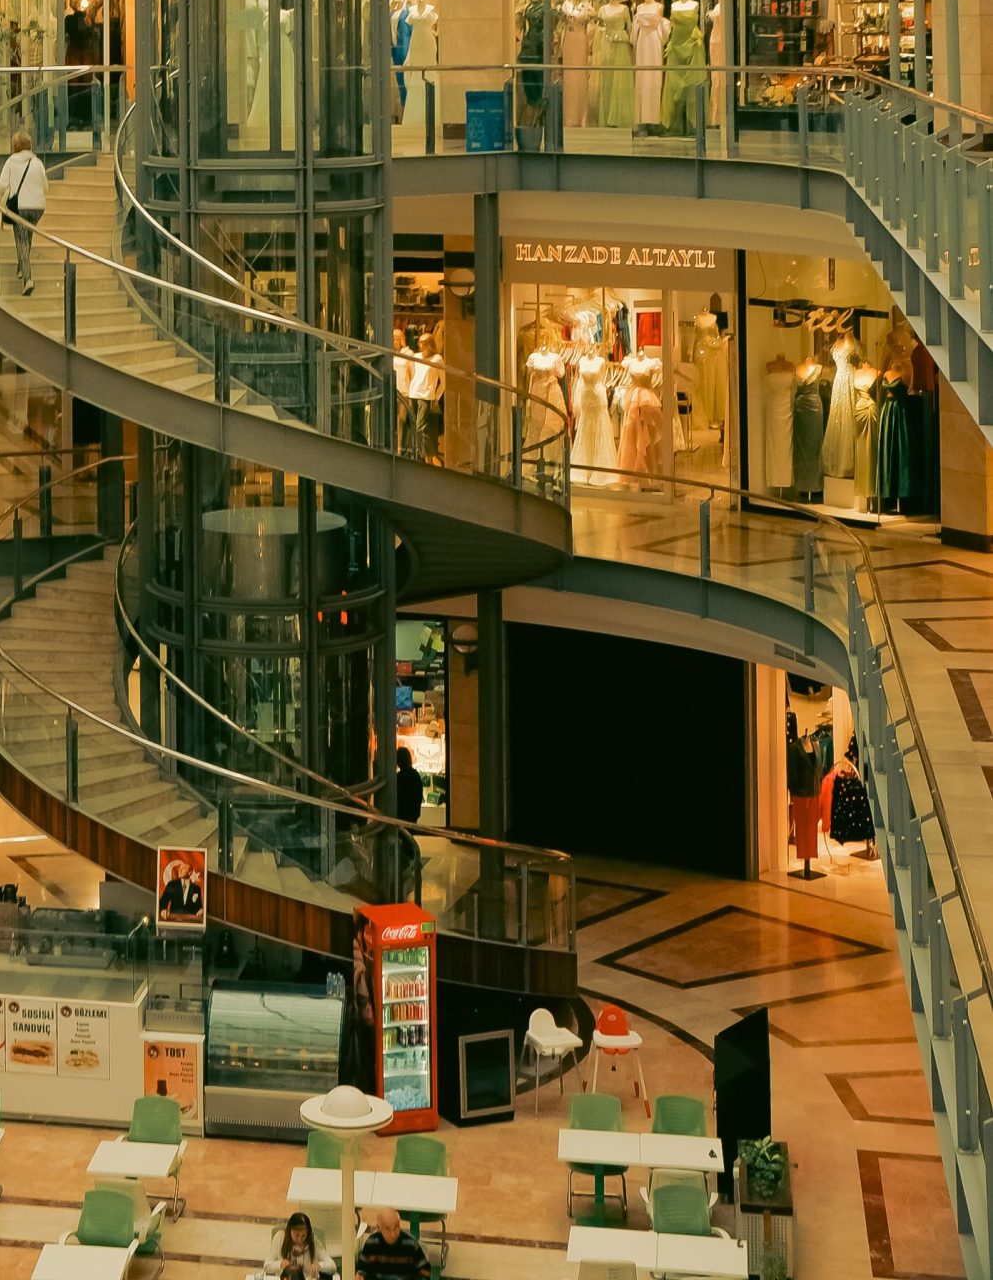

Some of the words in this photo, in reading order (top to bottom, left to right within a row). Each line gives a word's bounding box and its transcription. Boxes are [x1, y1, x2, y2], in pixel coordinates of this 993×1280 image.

[515, 243, 621, 265] HANZADE
[625, 247, 716, 269] ALTAYLI
[21, 1007, 55, 1021] SOSİSLİ
[12, 1021, 52, 1035] SANDVİÇ
[165, 1047, 186, 1058] TOST
